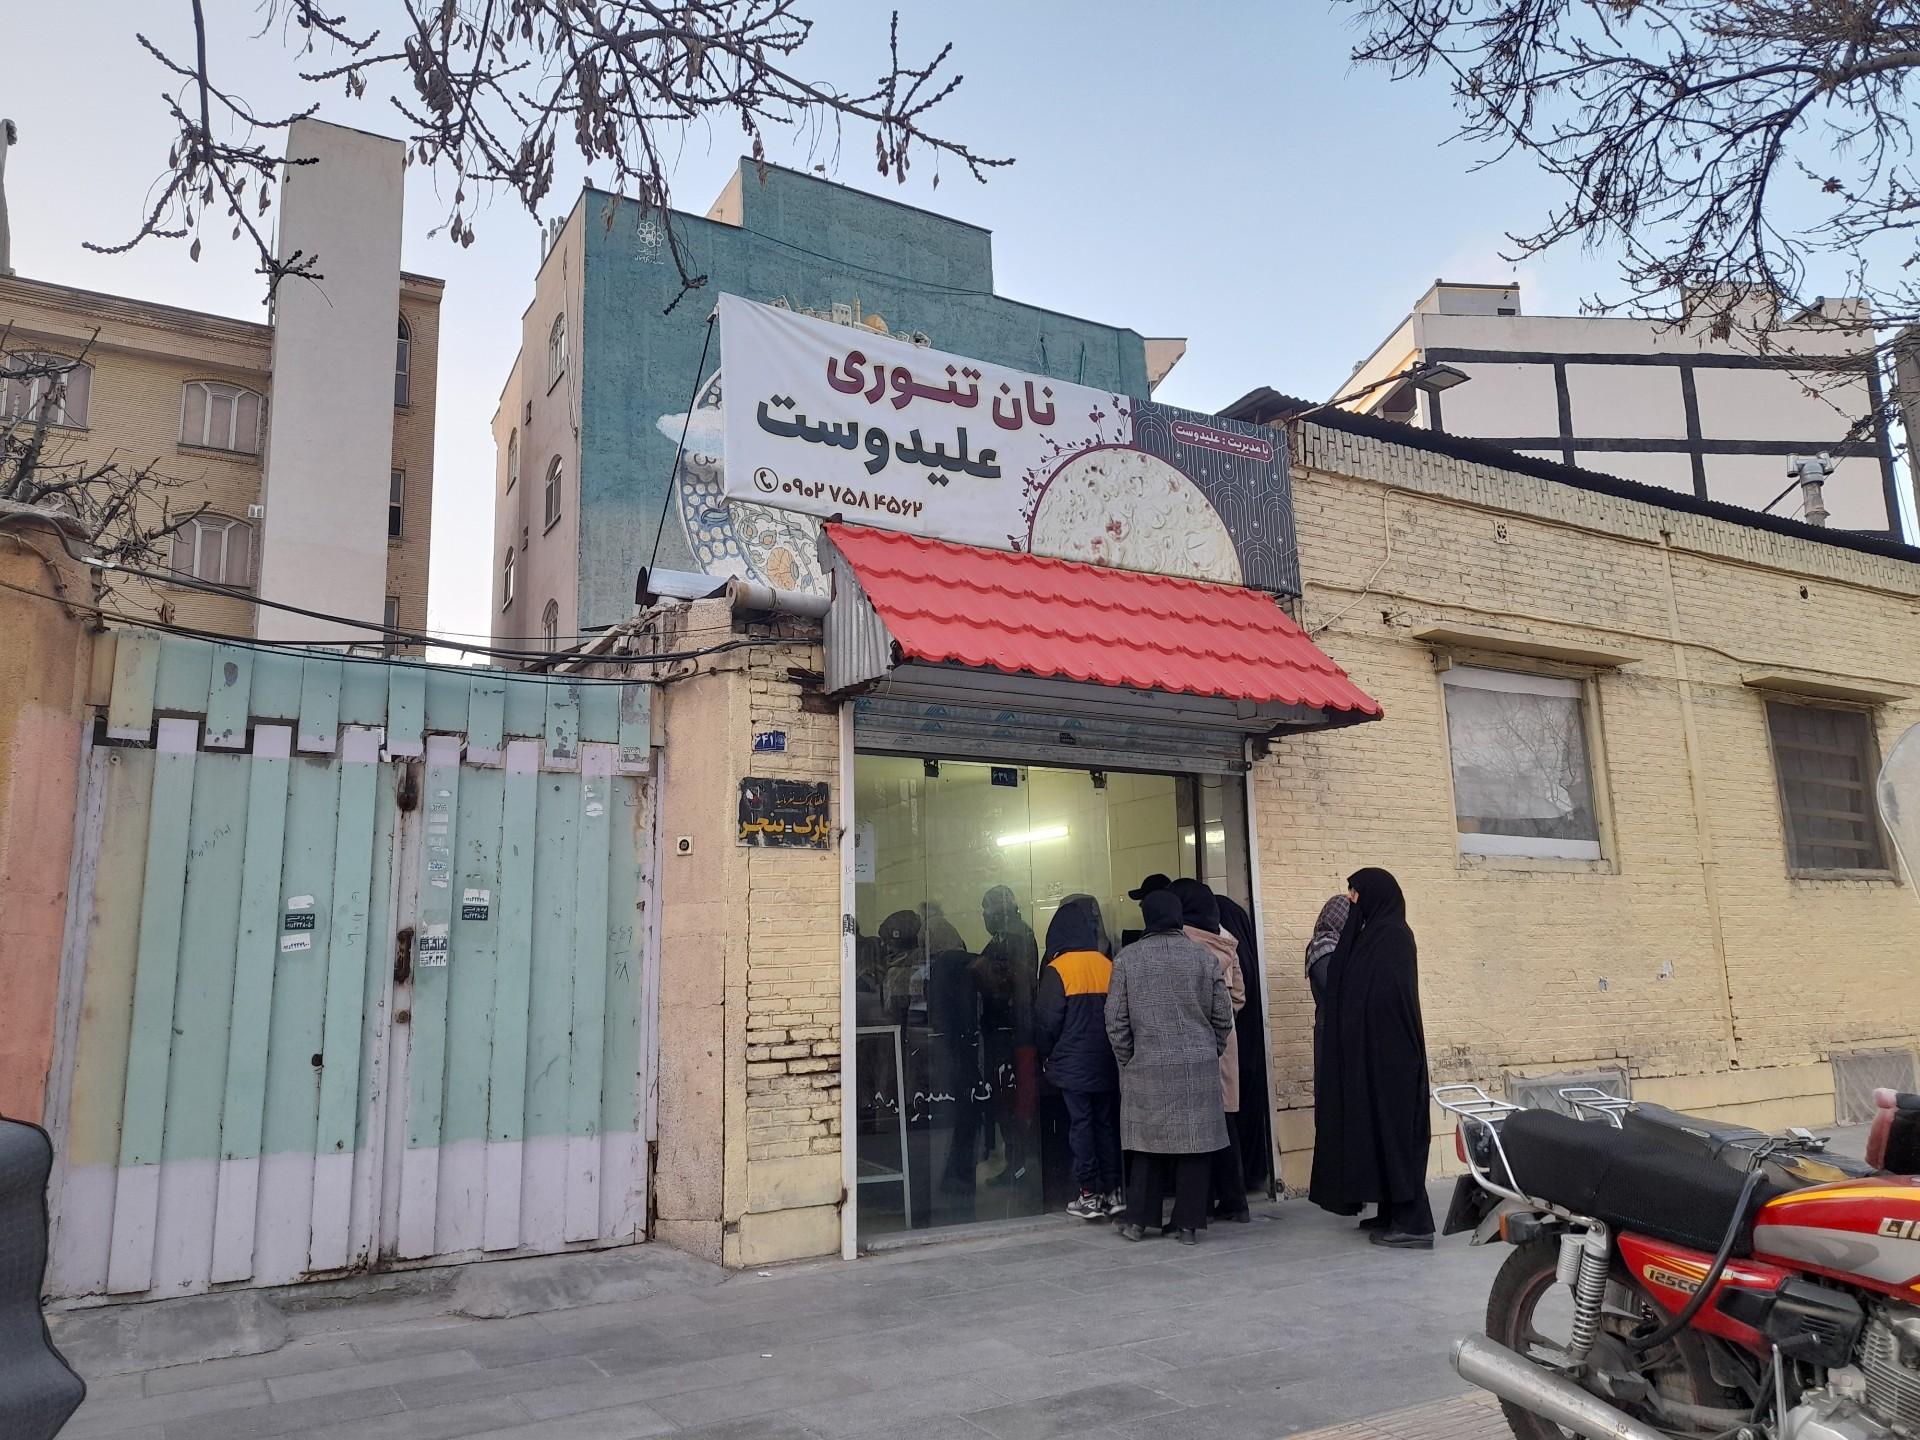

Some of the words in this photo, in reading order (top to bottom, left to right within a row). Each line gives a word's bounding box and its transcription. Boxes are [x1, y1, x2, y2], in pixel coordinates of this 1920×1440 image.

[826, 350, 982, 411] تنوری
[991, 380, 1056, 431] نان
[756, 393, 1002, 488] علیدوست
[1175, 424, 1221, 446] علیدوست
[1227, 438, 1261, 454] مدیریت
[1261, 442, 1270, 458] با
[782, 478, 825, 498] ۰۹۰۲
[829, 484, 870, 509] ۷۵۸
[874, 493, 923, 518] ۴۵۶۲
